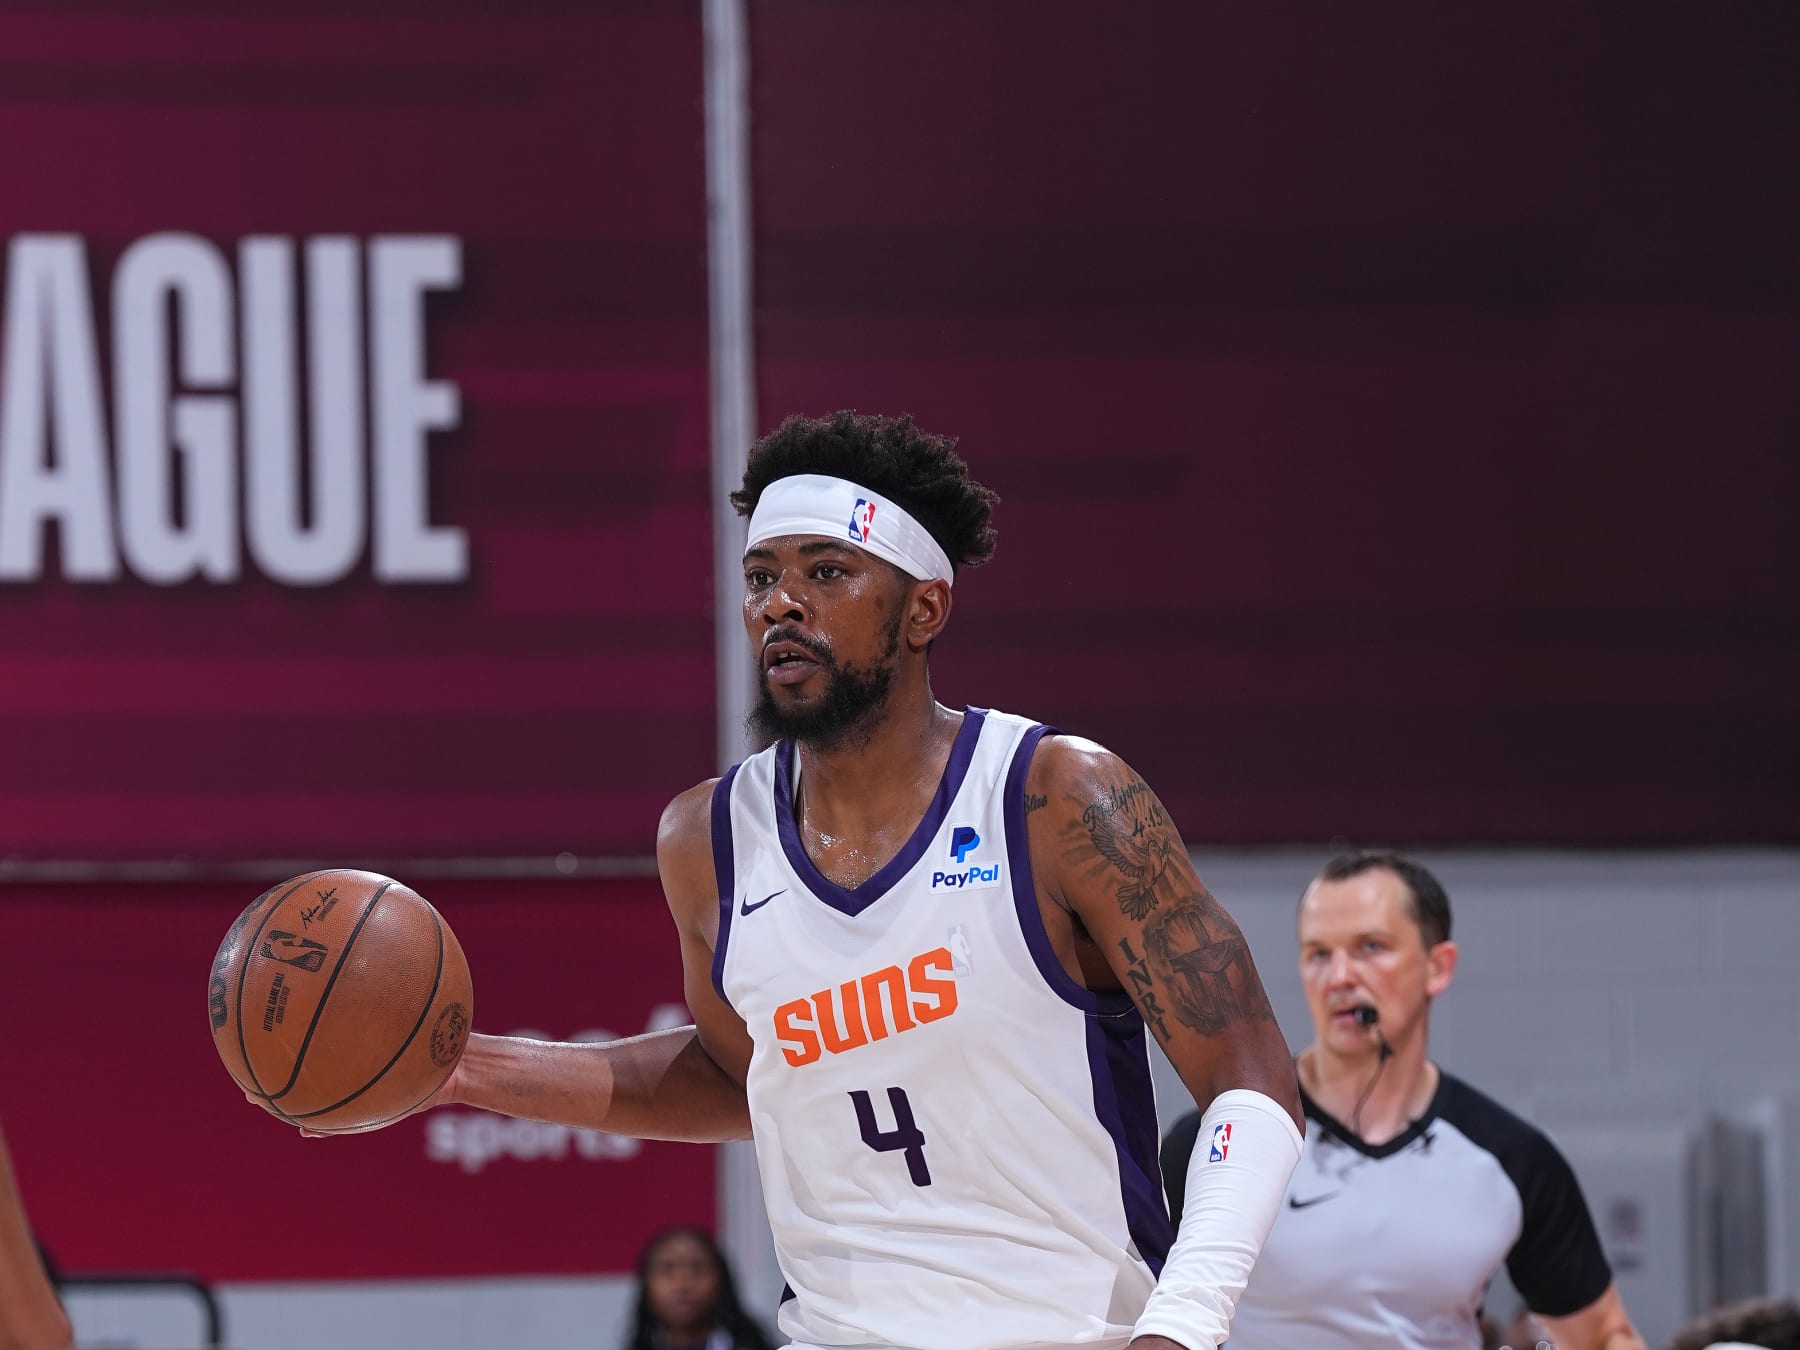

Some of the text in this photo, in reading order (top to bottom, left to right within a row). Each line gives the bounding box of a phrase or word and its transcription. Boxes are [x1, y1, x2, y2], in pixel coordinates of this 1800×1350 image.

[0, 230, 470, 588] AGUE
[932, 864, 999, 889] PayPal
[773, 947, 958, 1068] SUNS
[847, 1087, 932, 1188] 4
